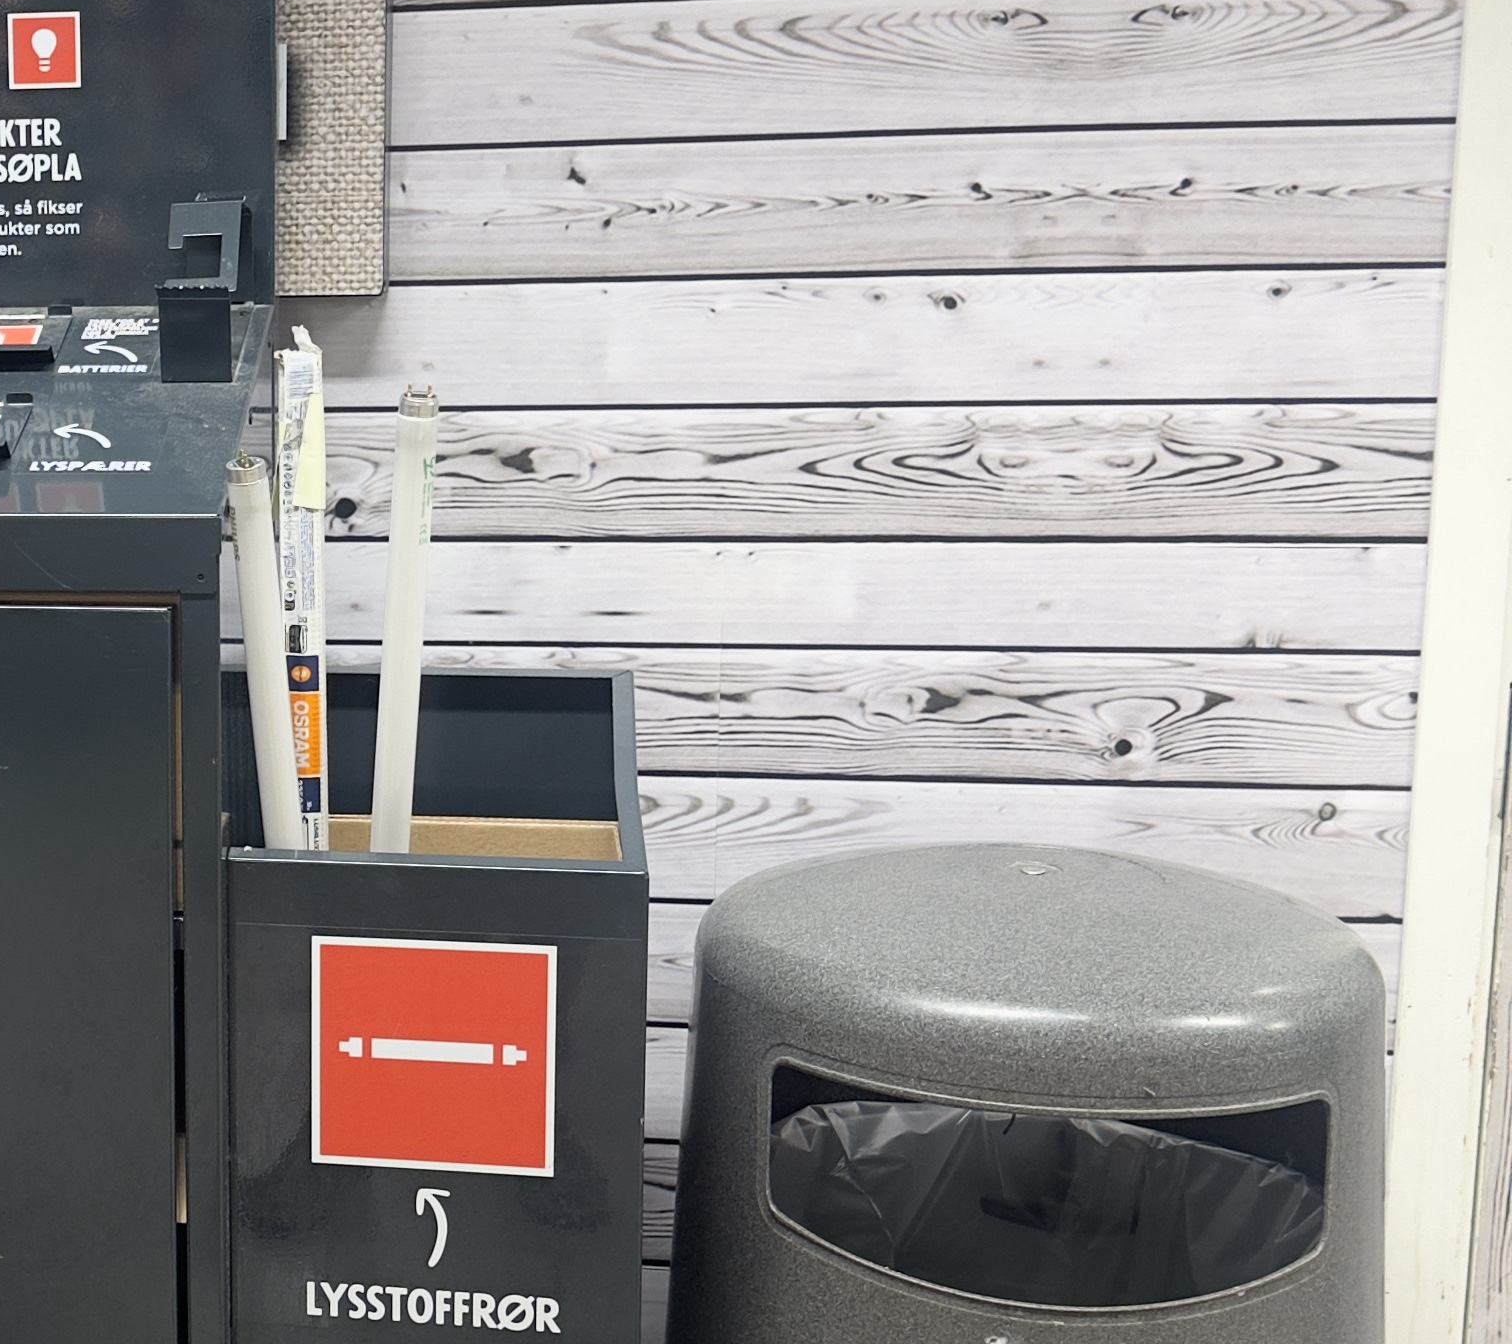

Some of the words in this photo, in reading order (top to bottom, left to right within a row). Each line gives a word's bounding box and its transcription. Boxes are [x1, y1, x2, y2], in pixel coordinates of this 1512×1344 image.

[15, 200, 32, 216] så
[37, 200, 83, 215] fikser
[46, 224, 80, 235] som
[58, 365, 147, 373] BATTERIER
[29, 461, 151, 471] LYSPÆRER
[293, 699, 311, 770] OSRAM
[306, 1281, 561, 1334] LYSSTOFFRØR
